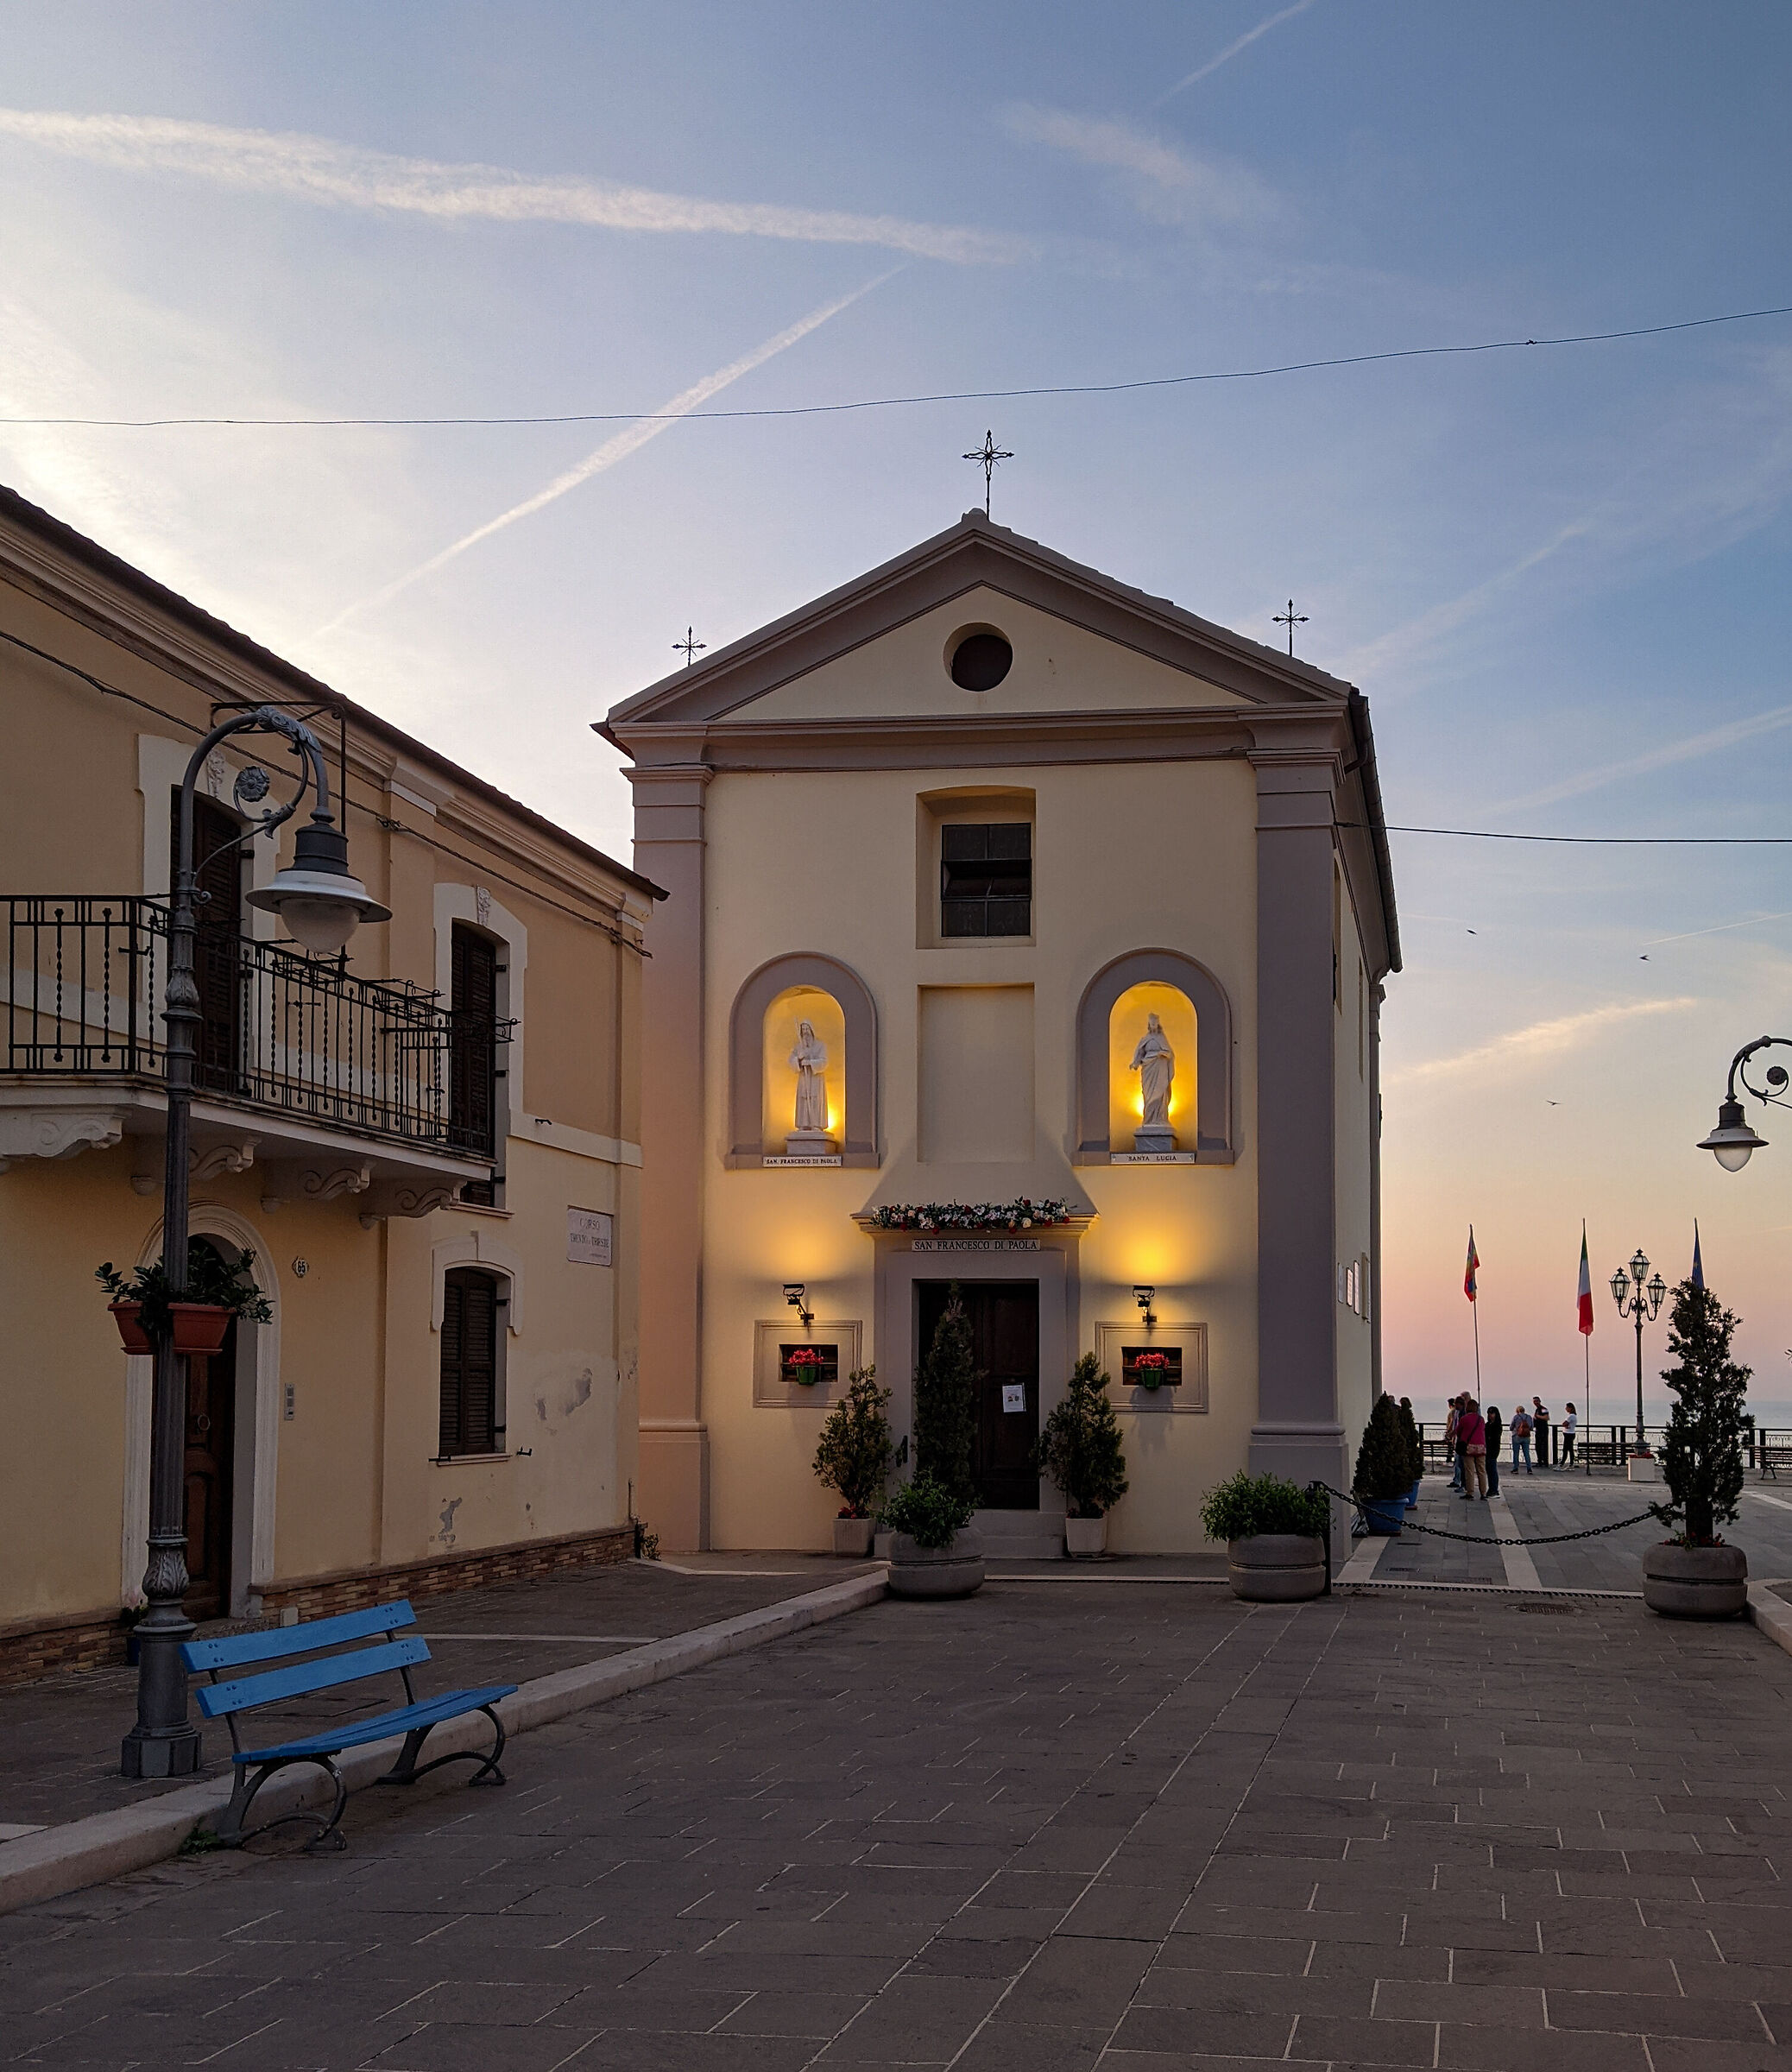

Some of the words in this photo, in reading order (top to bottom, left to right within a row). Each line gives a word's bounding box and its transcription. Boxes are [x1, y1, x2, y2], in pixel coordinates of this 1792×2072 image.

[914, 1241, 932, 1250] SAN
[937, 1241, 990, 1250] FRANCESCO
[994, 1241, 1003, 1250] DI
[1008, 1240, 1037, 1250] PAOLA
[298, 1260, 306, 1273] 65
